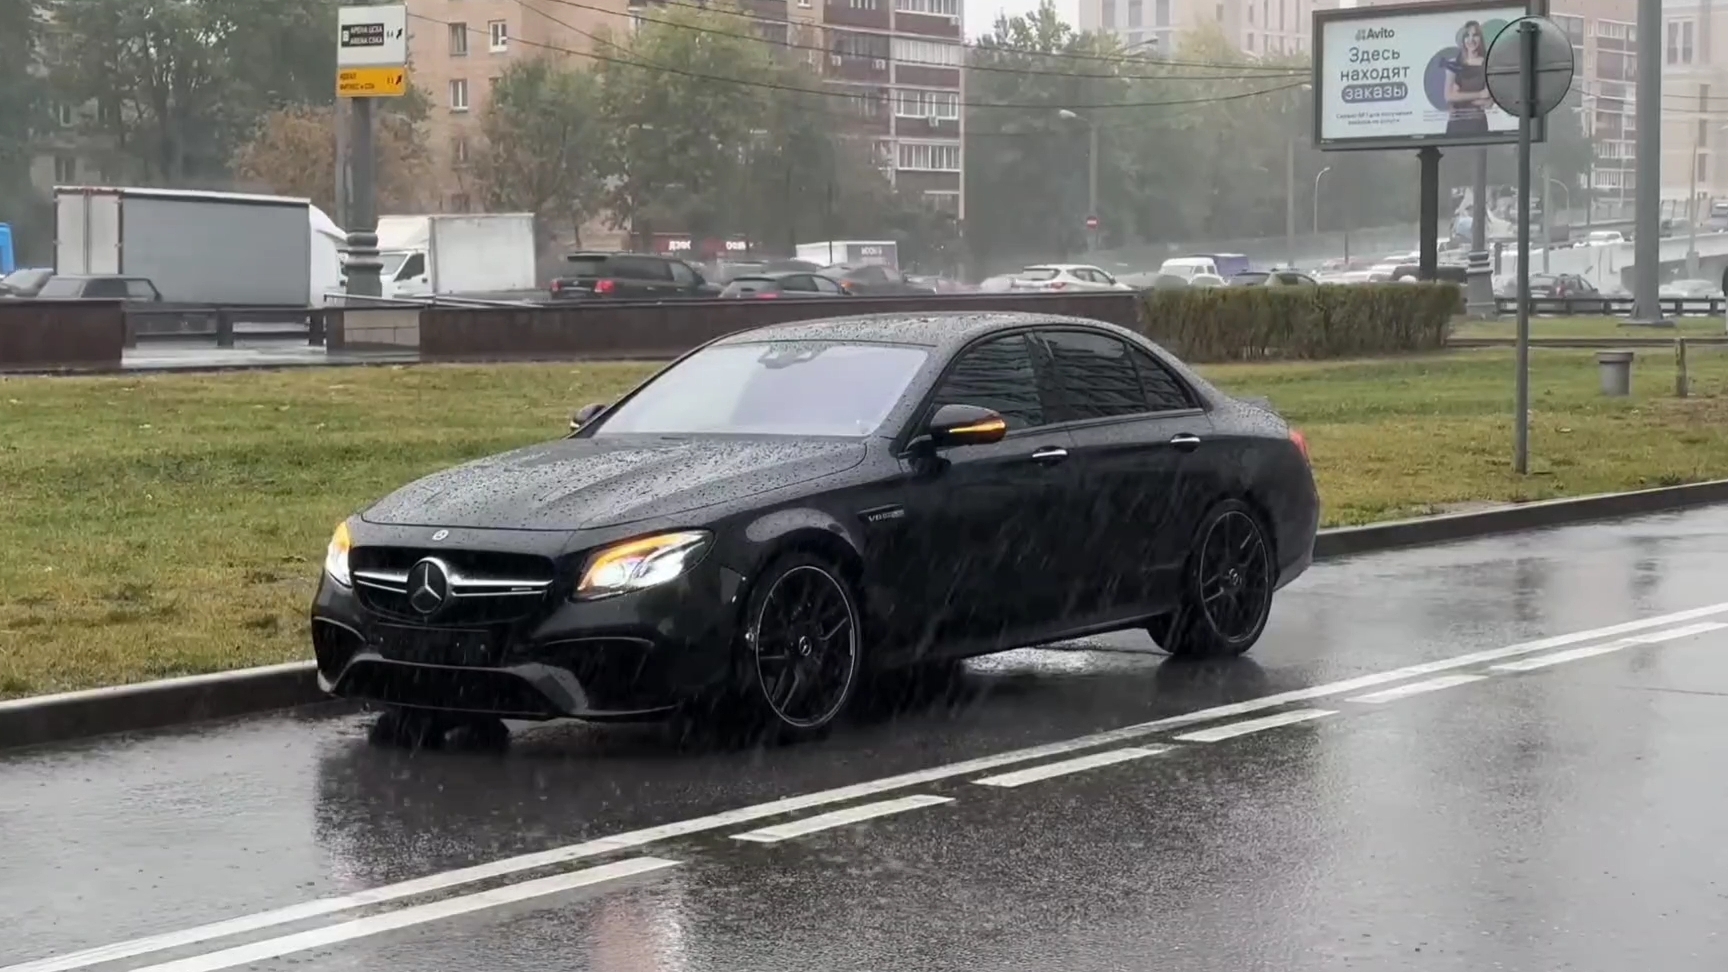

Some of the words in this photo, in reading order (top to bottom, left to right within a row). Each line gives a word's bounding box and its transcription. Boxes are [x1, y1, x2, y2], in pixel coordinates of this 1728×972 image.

[1366, 27, 1395, 39] Avito
[1349, 47, 1401, 64] Здесь
[1340, 66, 1410, 82] находят
[1345, 86, 1406, 100] заказы
